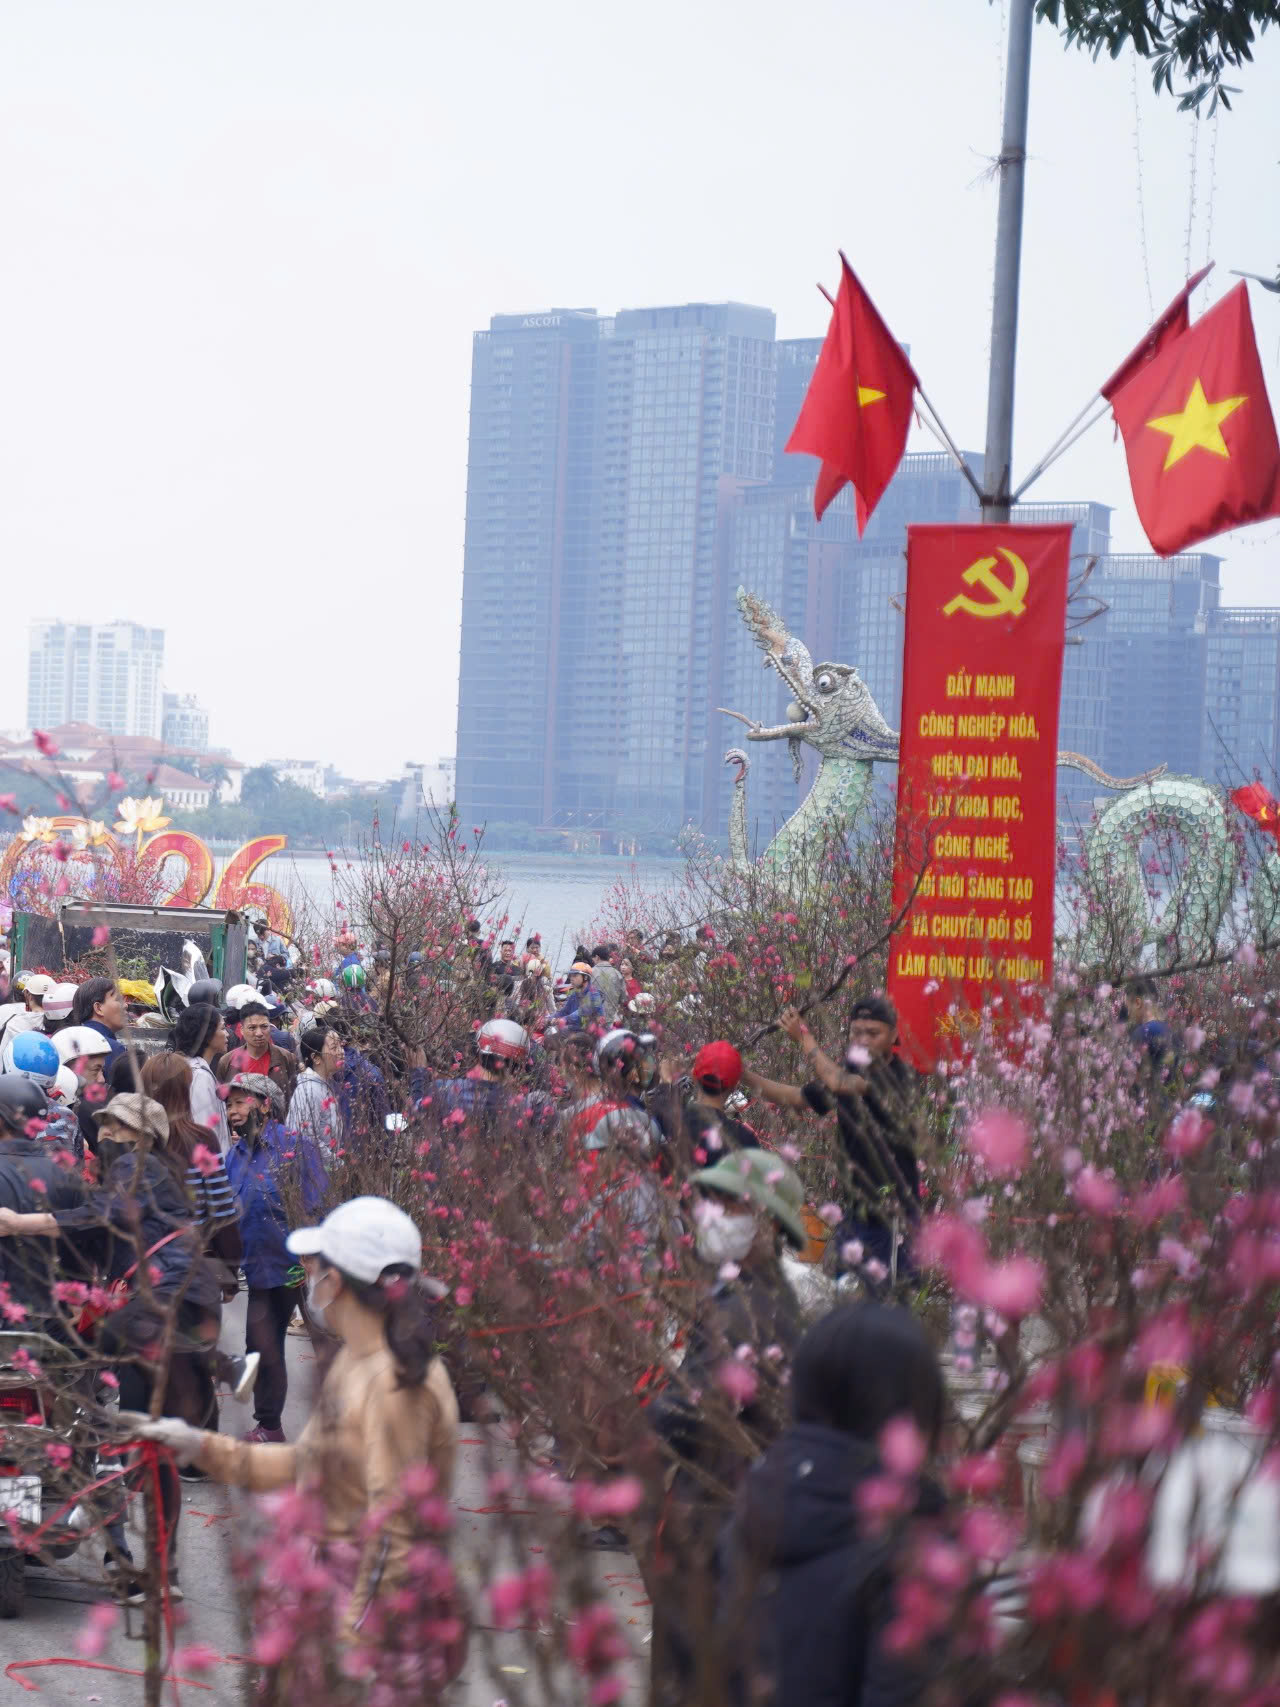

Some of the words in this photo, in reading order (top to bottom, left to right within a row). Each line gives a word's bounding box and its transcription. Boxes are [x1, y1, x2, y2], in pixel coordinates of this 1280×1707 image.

[946, 666, 972, 697] ĐẨY
[975, 674, 1015, 702] MẠNH
[920, 710, 955, 737] CÔNG
[958, 711, 1006, 742] NGHIỆP
[1009, 711, 1040, 741] HÓA,
[932, 750, 963, 781] HIỆN
[966, 755, 989, 782] ĐẠI
[991, 752, 1022, 782] HÓA,
[955, 795, 990, 818] KHOA
[993, 795, 1024, 823] HỌC,
[935, 831, 971, 858] CÔNG
[974, 832, 1014, 863] NGHỆ,
[939, 872, 964, 898] MỚI
[968, 873, 1004, 899] SÁNG
[1007, 877, 1033, 905] TẠO
[912, 911, 928, 936] VÀ
[987, 910, 1010, 940] ĐỔI
[1014, 911, 1032, 941] SỐ
[897, 951, 925, 977] LÀM
[928, 951, 965, 982] ĐỘNG
[969, 955, 994, 983] LỰC
